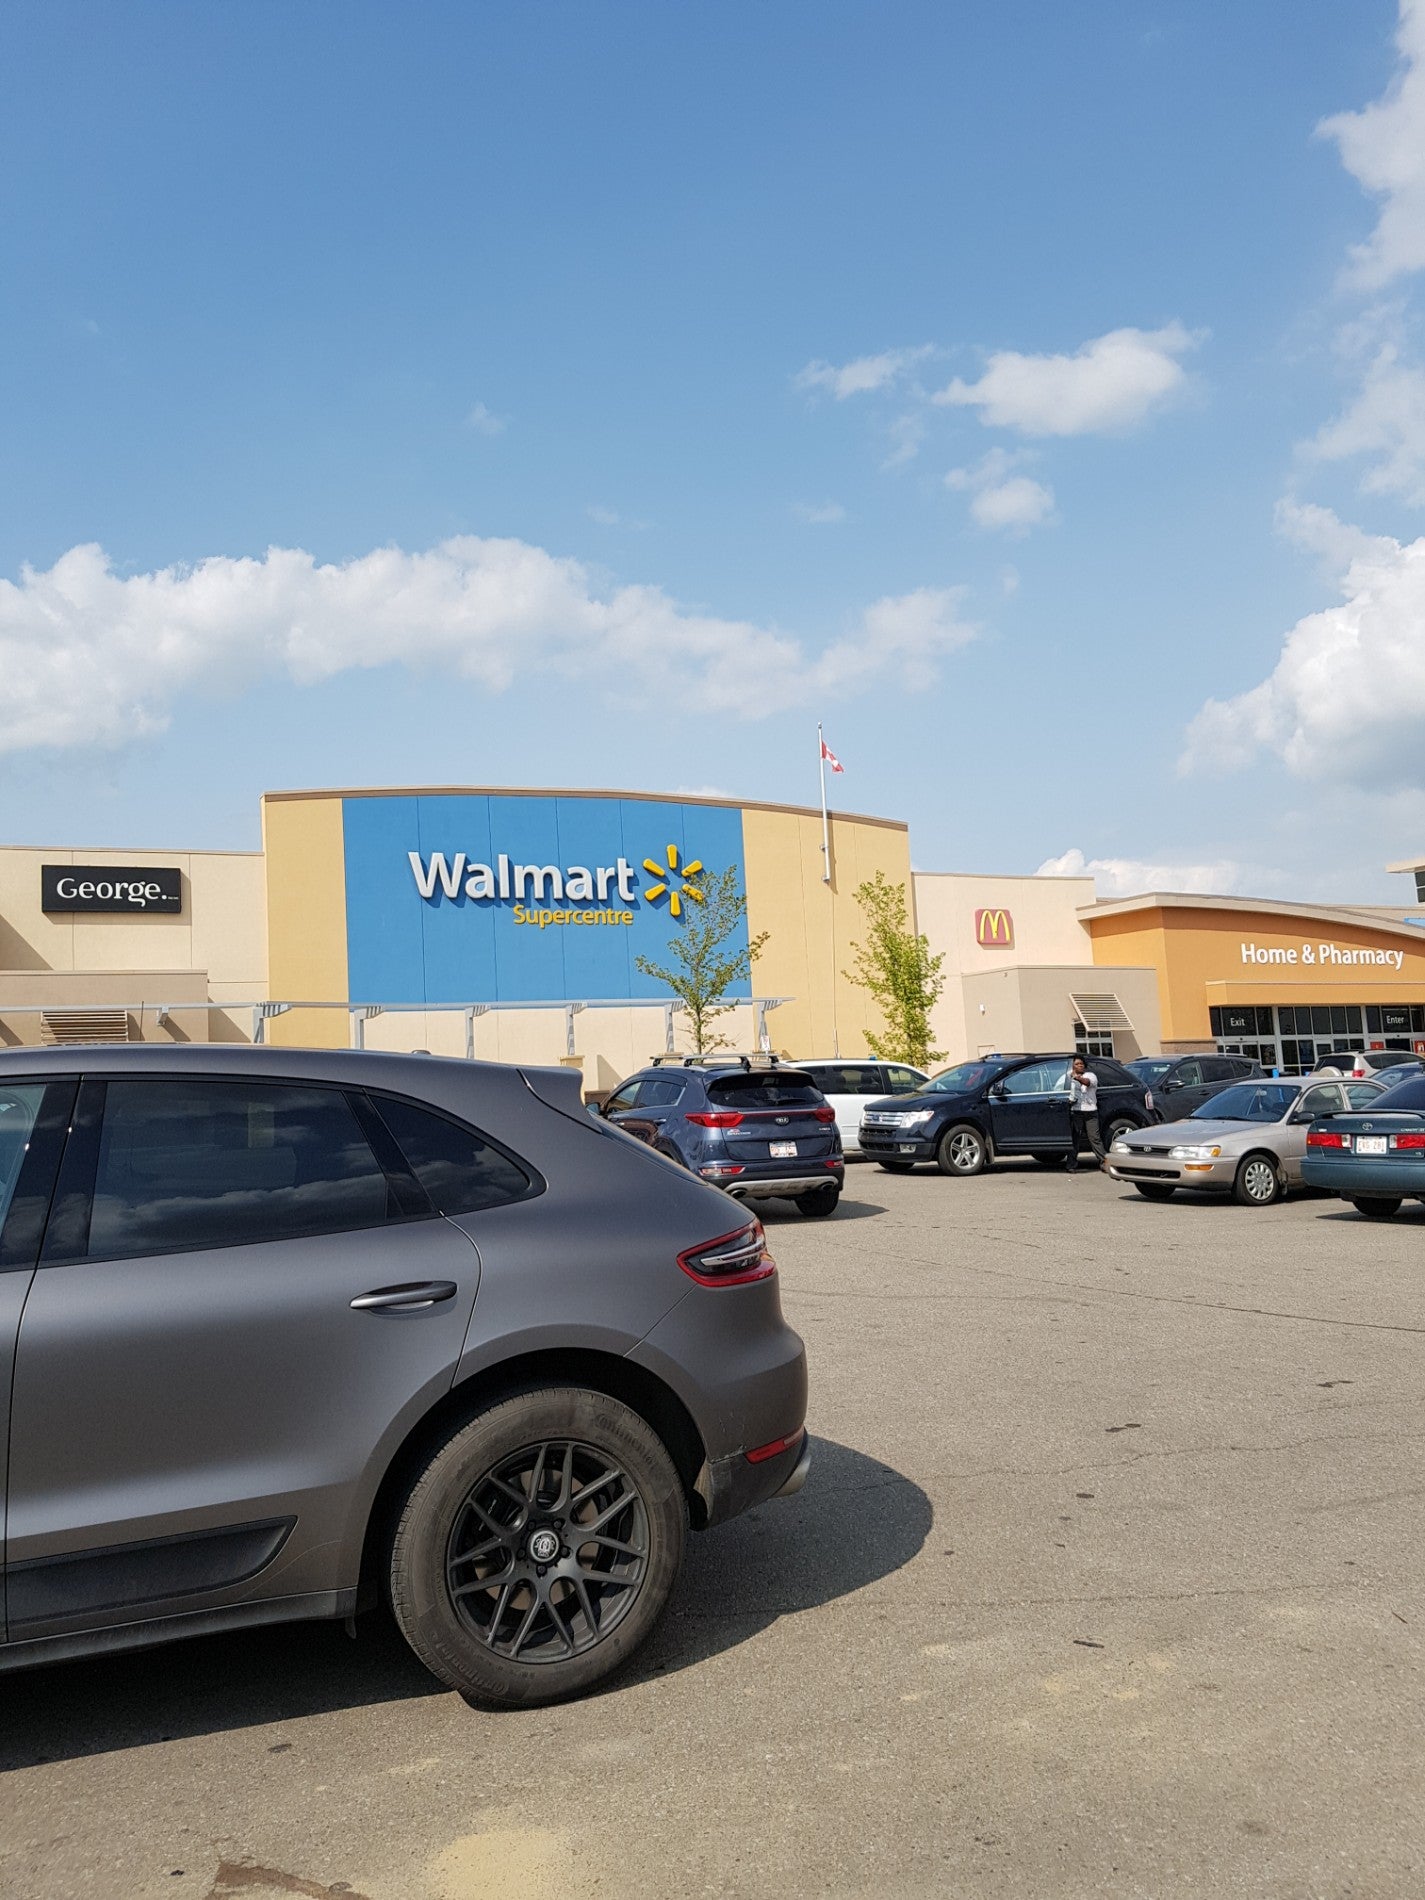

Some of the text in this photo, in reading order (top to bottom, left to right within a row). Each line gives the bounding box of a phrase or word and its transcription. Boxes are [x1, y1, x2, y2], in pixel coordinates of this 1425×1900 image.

[407, 852, 634, 901] Walmart
[513, 904, 634, 929] Supercentre
[1241, 943, 1404, 970] Home & Pharmacy
[1230, 1017, 1246, 1027] Exit
[1386, 1015, 1405, 1025] Enter
